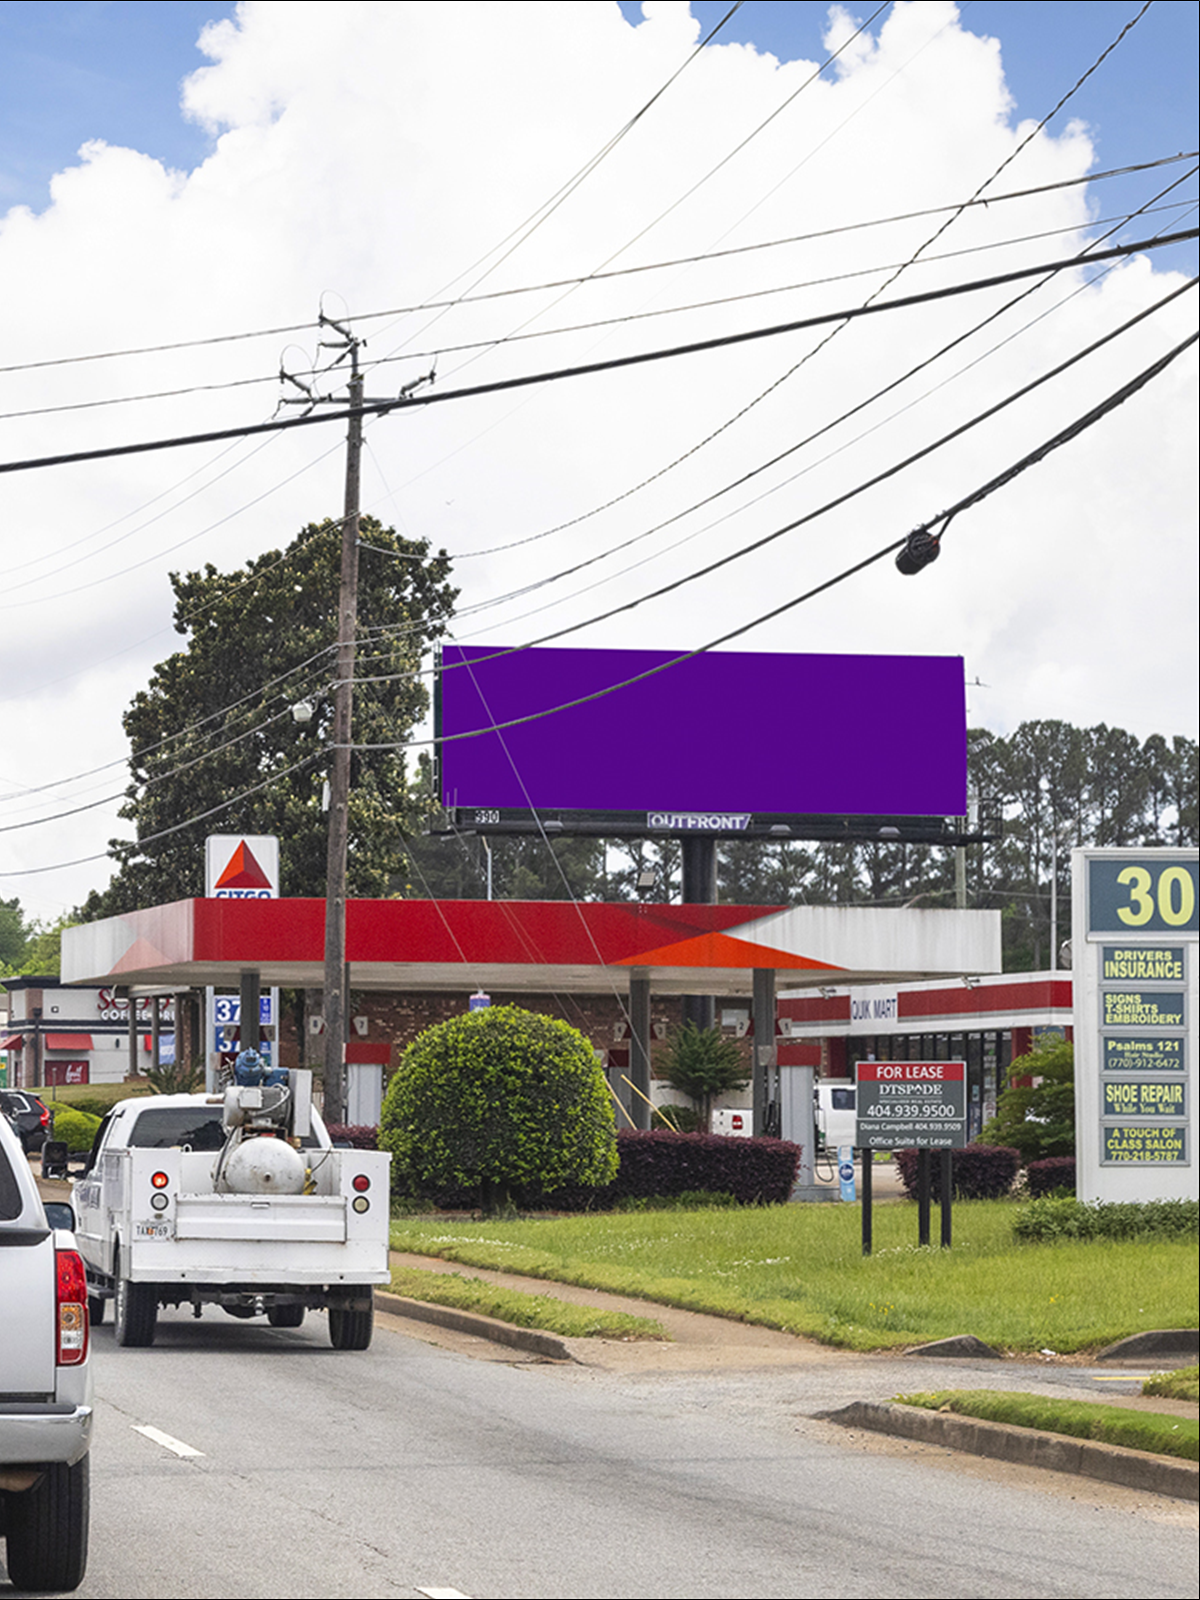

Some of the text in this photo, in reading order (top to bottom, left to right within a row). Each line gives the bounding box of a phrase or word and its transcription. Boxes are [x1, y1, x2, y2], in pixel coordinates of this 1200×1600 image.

[651, 814, 745, 829] OUTFRONT
[1116, 866, 1195, 926] 30
[1114, 951, 1172, 961] DRIVERS
[1104, 961, 1182, 978] INSURANCE
[1105, 994, 1142, 1004] SIGNS
[217, 1000, 241, 1021] 37
[852, 998, 896, 1019] QUIK MART
[1105, 1004, 1159, 1014] T-SHIRTS
[101, 1010, 148, 1020] COFE
[1105, 1014, 1182, 1024] EMBROIDERY
[738, 1022, 744, 1030] 2
[1107, 1041, 1179, 1051] Psalms 121
[1108, 1058, 1180, 1069] (770)-912-6472
[876, 1066, 944, 1079] FOR LEASE
[1106, 1084, 1183, 1103] SHOE REPAIR
[867, 1104, 955, 1117] 404.939.9500
[1114, 1103, 1175, 1113] While You Wait
[860, 1122, 879, 1131] Diana
[881, 1122, 913, 1132] Campbell
[1112, 1128, 1176, 1138] A TOUCH OF
[869, 1136, 953, 1145] Office Suite for Lease
[1107, 1139, 1182, 1150] CLASS SALON
[1110, 1151, 1179, 1161] 770-218-5787
